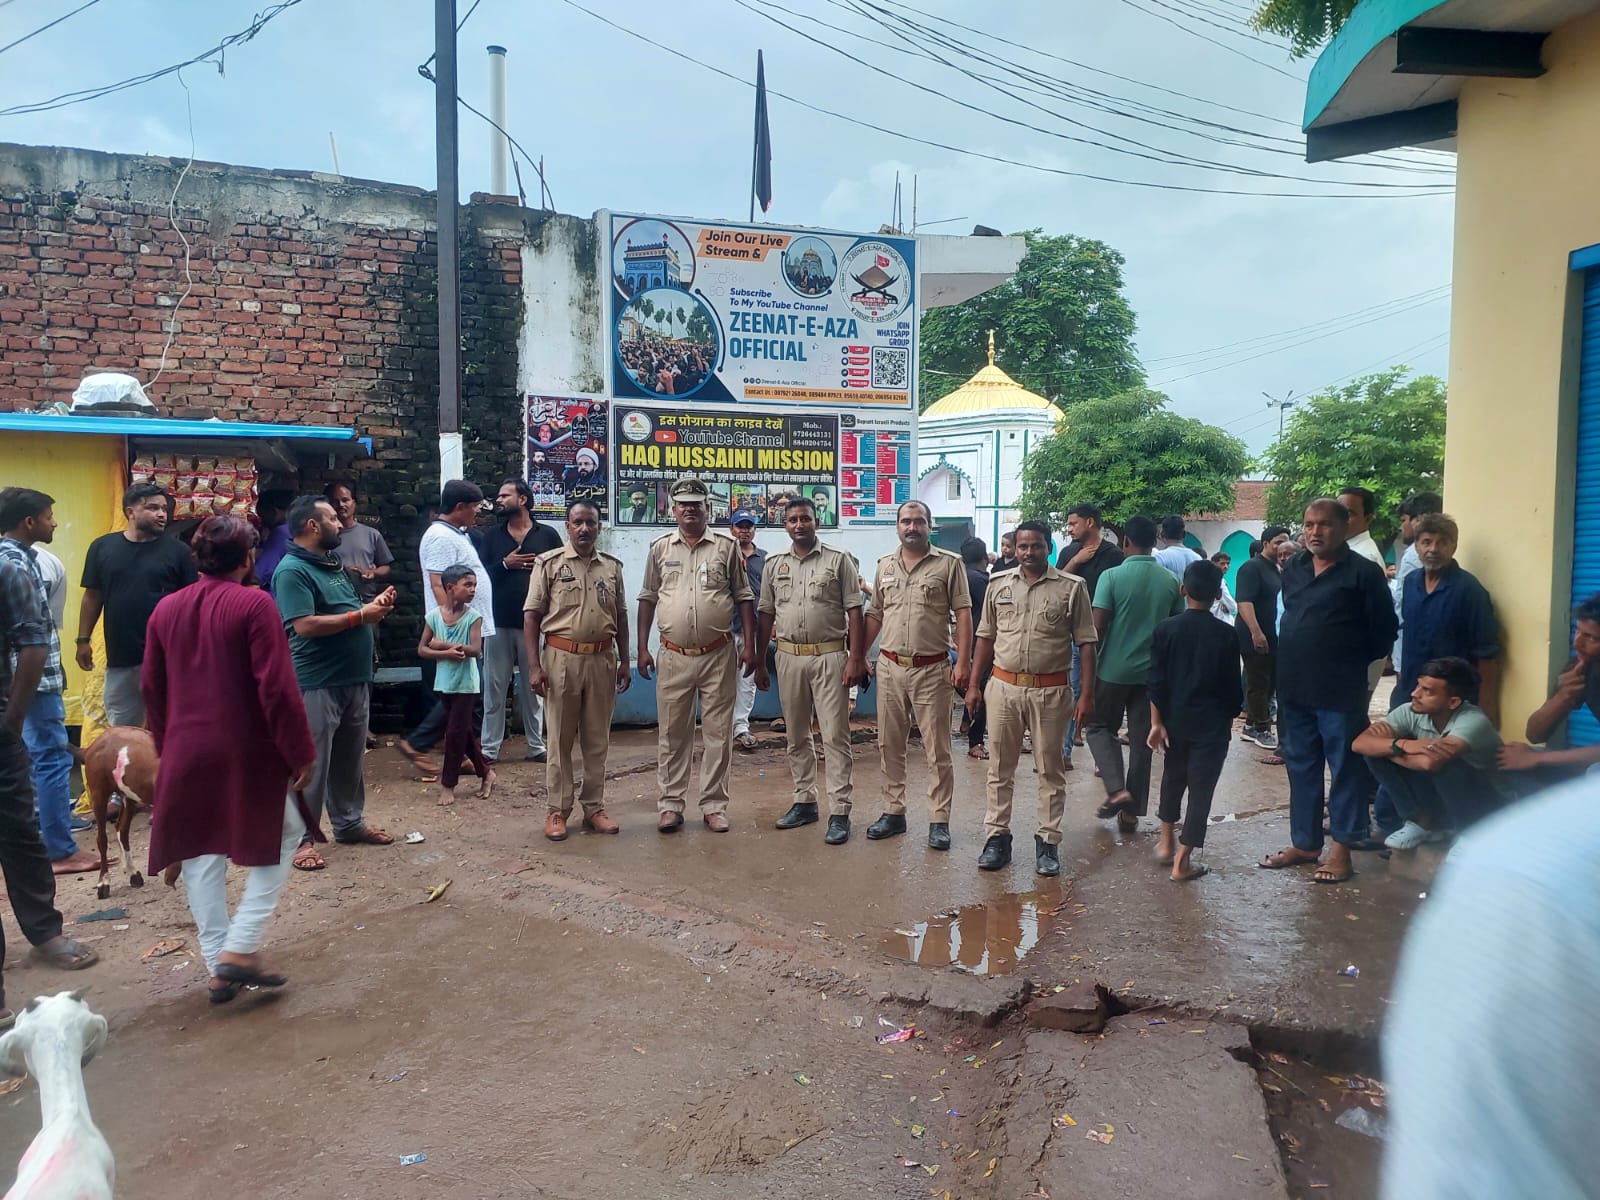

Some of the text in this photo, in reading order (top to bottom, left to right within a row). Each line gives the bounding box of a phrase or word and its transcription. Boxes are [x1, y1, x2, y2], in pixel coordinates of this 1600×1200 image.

[706, 230, 783, 246] Join Our Live
[705, 244, 761, 259] Stream &
[730, 288, 772, 298] Subscribe
[730, 298, 828, 312] To My YouTube Channel
[729, 311, 858, 339] ZEENAT-E-AZA
[896, 322, 910, 331] JOIN
[877, 329, 910, 337] WHATSAPP
[729, 337, 807, 362] OFFICIAL
[889, 338, 910, 346] GROUP
[659, 413, 784, 430] इस प्रोग्राम का लाइव देखें
[802, 421, 822, 429] Mob.:
[678, 428, 785, 447] YouTube Channel
[621, 444, 834, 471] HAQ HUSSAINI MISSION
